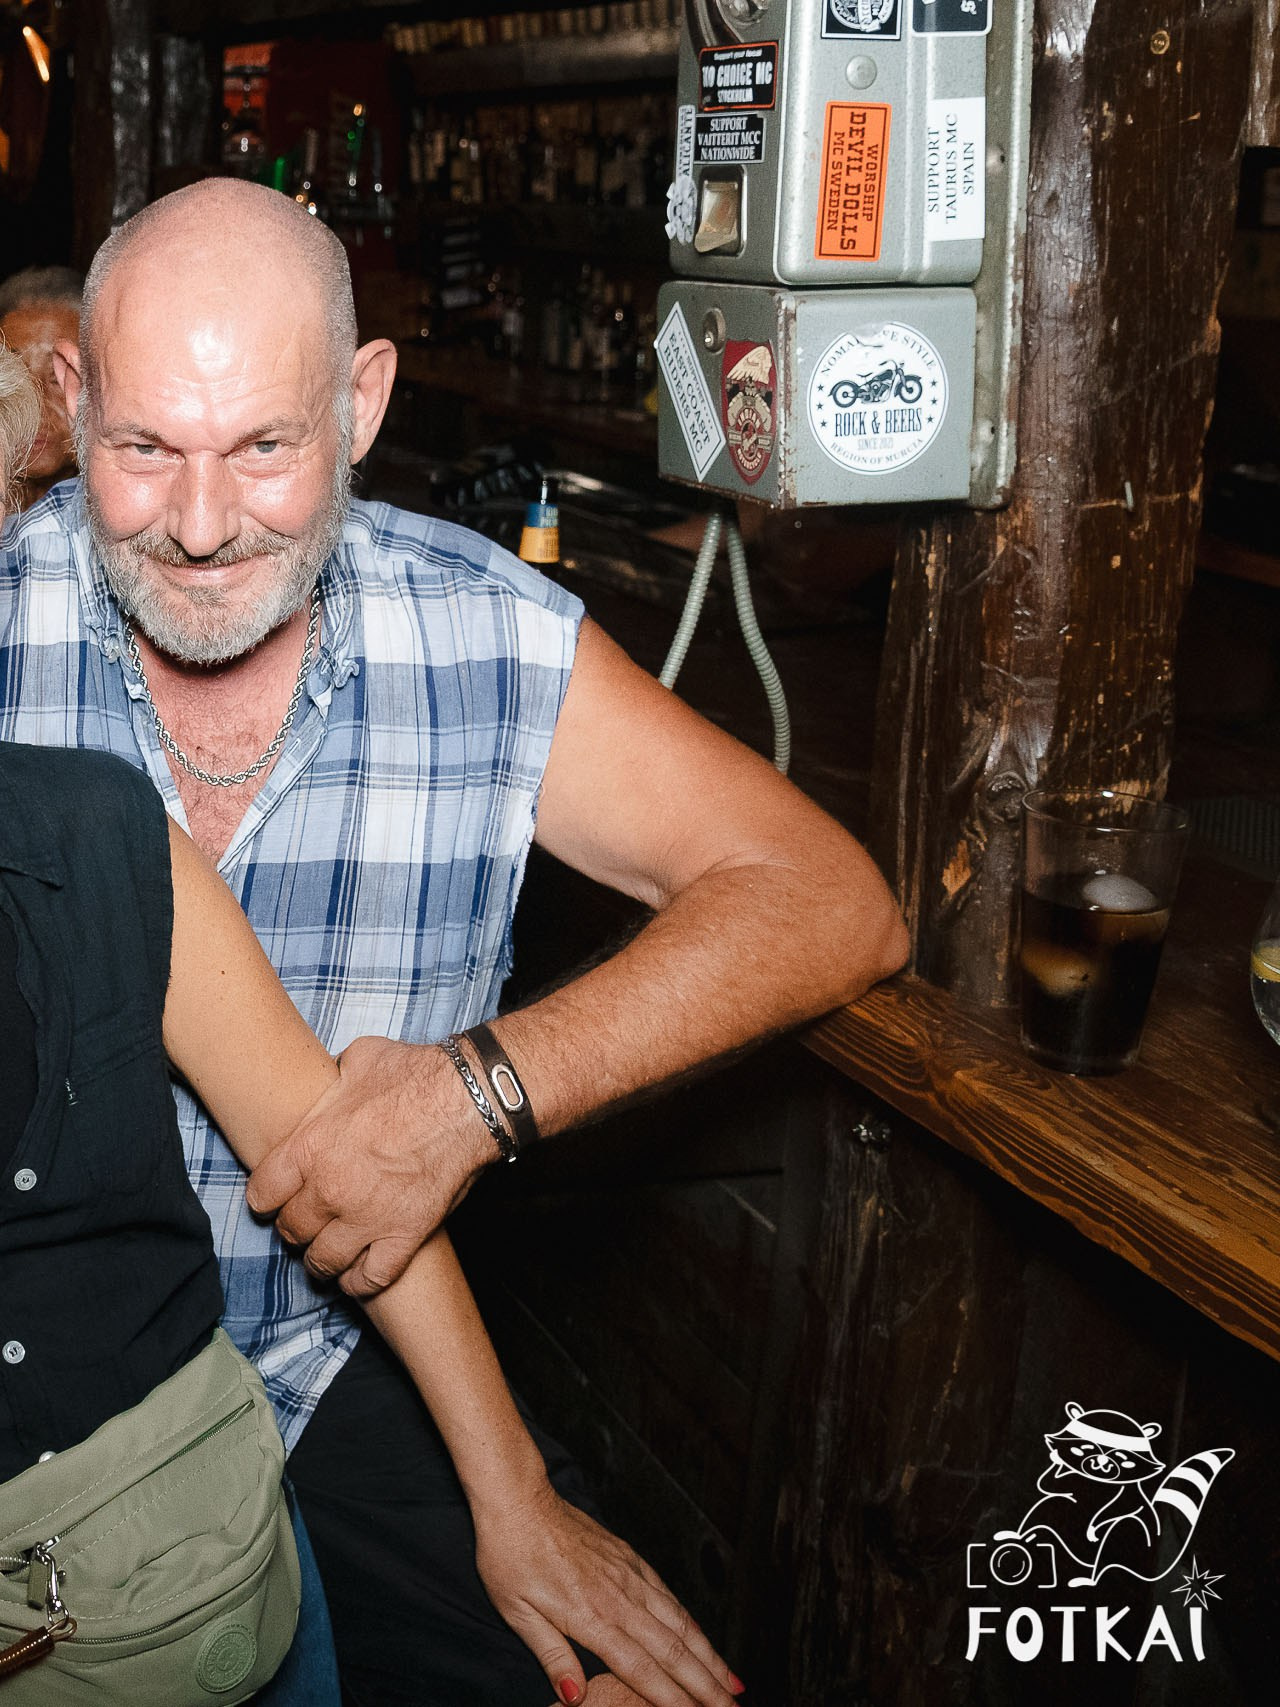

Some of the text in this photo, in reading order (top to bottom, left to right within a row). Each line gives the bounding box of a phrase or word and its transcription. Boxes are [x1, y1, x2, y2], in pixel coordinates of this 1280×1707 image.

[716, 62, 753, 87] CHOICE
[755, 61, 773, 85] MC
[681, 107, 693, 177] ALICANTE
[701, 146, 756, 160] NATIONWIDE
[710, 117, 748, 131] SUPPORT
[740, 130, 761, 145] MCC
[826, 131, 845, 231] MC SWEDEN
[840, 111, 867, 250] DEVIL DOLLS
[862, 144, 878, 222] WORSHIP
[927, 127, 939, 213] SUPPORT
[945, 113, 958, 224] TAURUS MC
[963, 142, 974, 195] SPAIN
[902, 335, 937, 370] STYLE
[664, 345, 703, 453] RIDERS MC
[669, 333, 710, 446] EAST COAST
[830, 441, 867, 464] REGION
[885, 438, 923, 462] MURCIA
[835, 408, 922, 437] ROCK & BEERS
